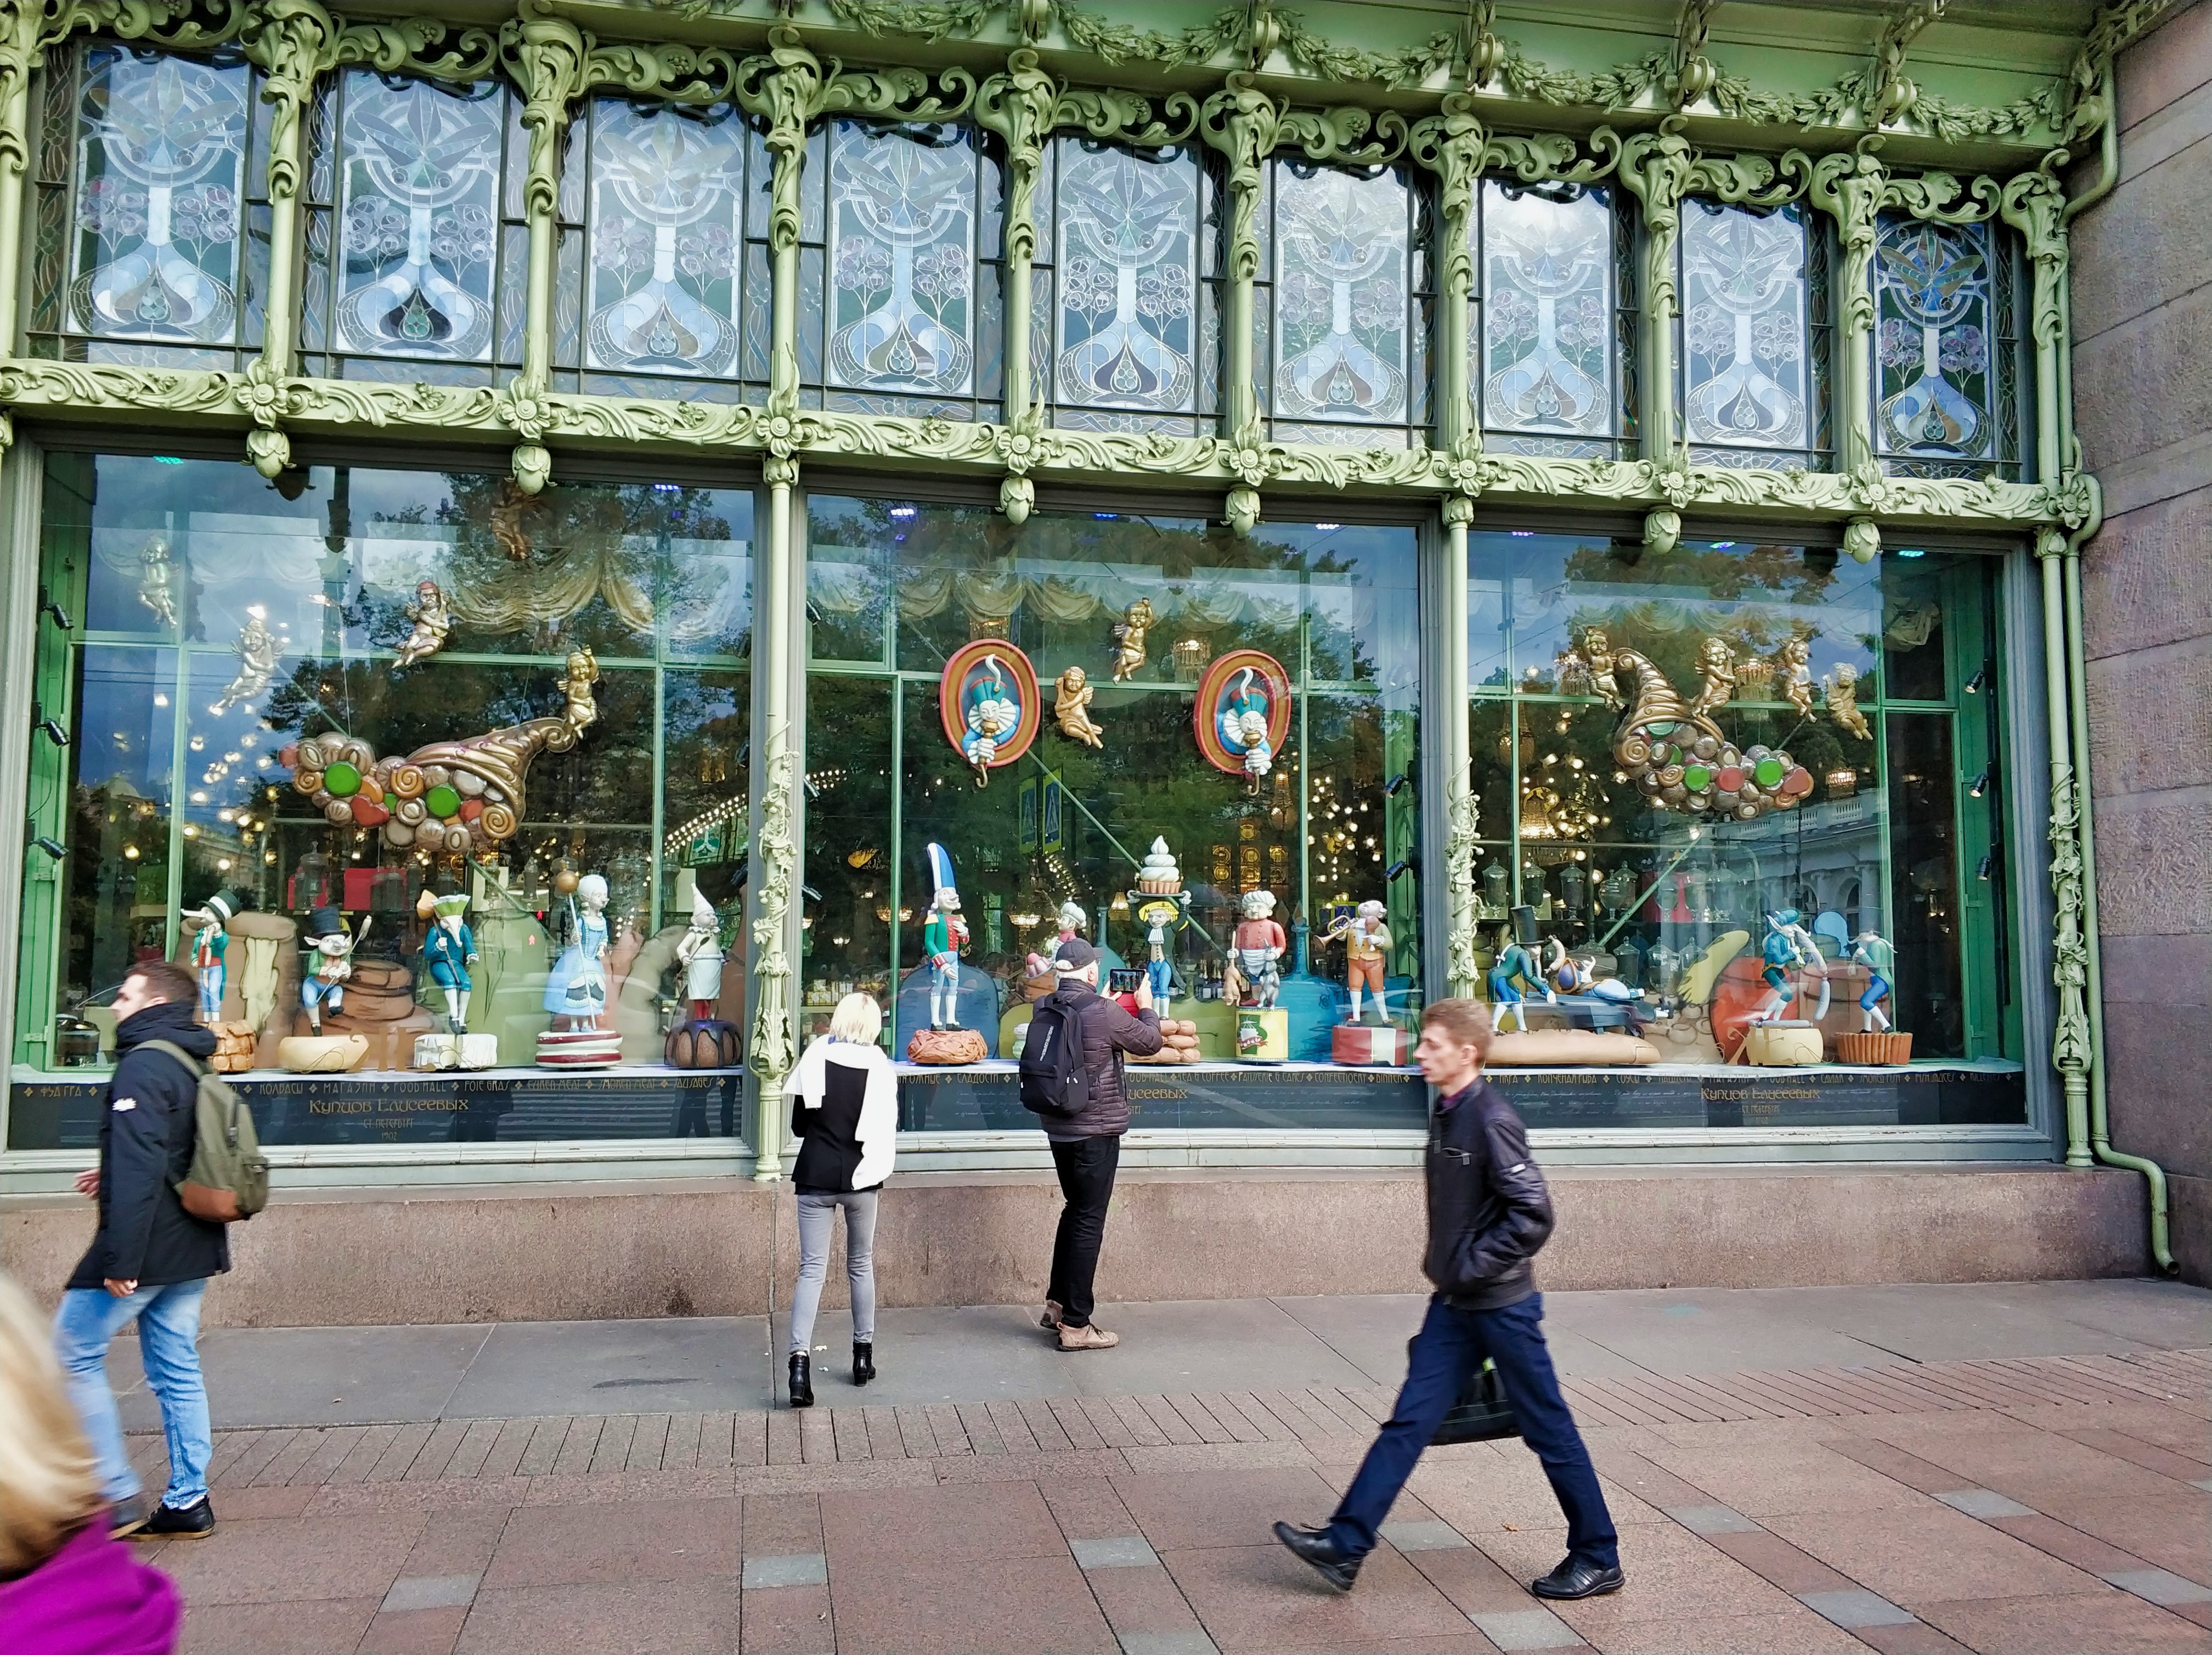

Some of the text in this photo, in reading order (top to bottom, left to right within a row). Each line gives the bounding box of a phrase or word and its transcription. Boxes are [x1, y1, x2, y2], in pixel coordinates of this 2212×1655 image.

[957, 1073, 998, 1084] СЛАДОСТИ
[1201, 1072, 1229, 1082] COFFEE
[1376, 1073, 1402, 1083] DINNER
[423, 1082, 446, 1092] HALL
[465, 1080, 510, 1091] FOIE GRAS
[674, 1078, 714, 1089] SAUSAGES
[309, 1098, 469, 1114] Купцов Елисеевых
[381, 1132, 397, 1141] 1902
